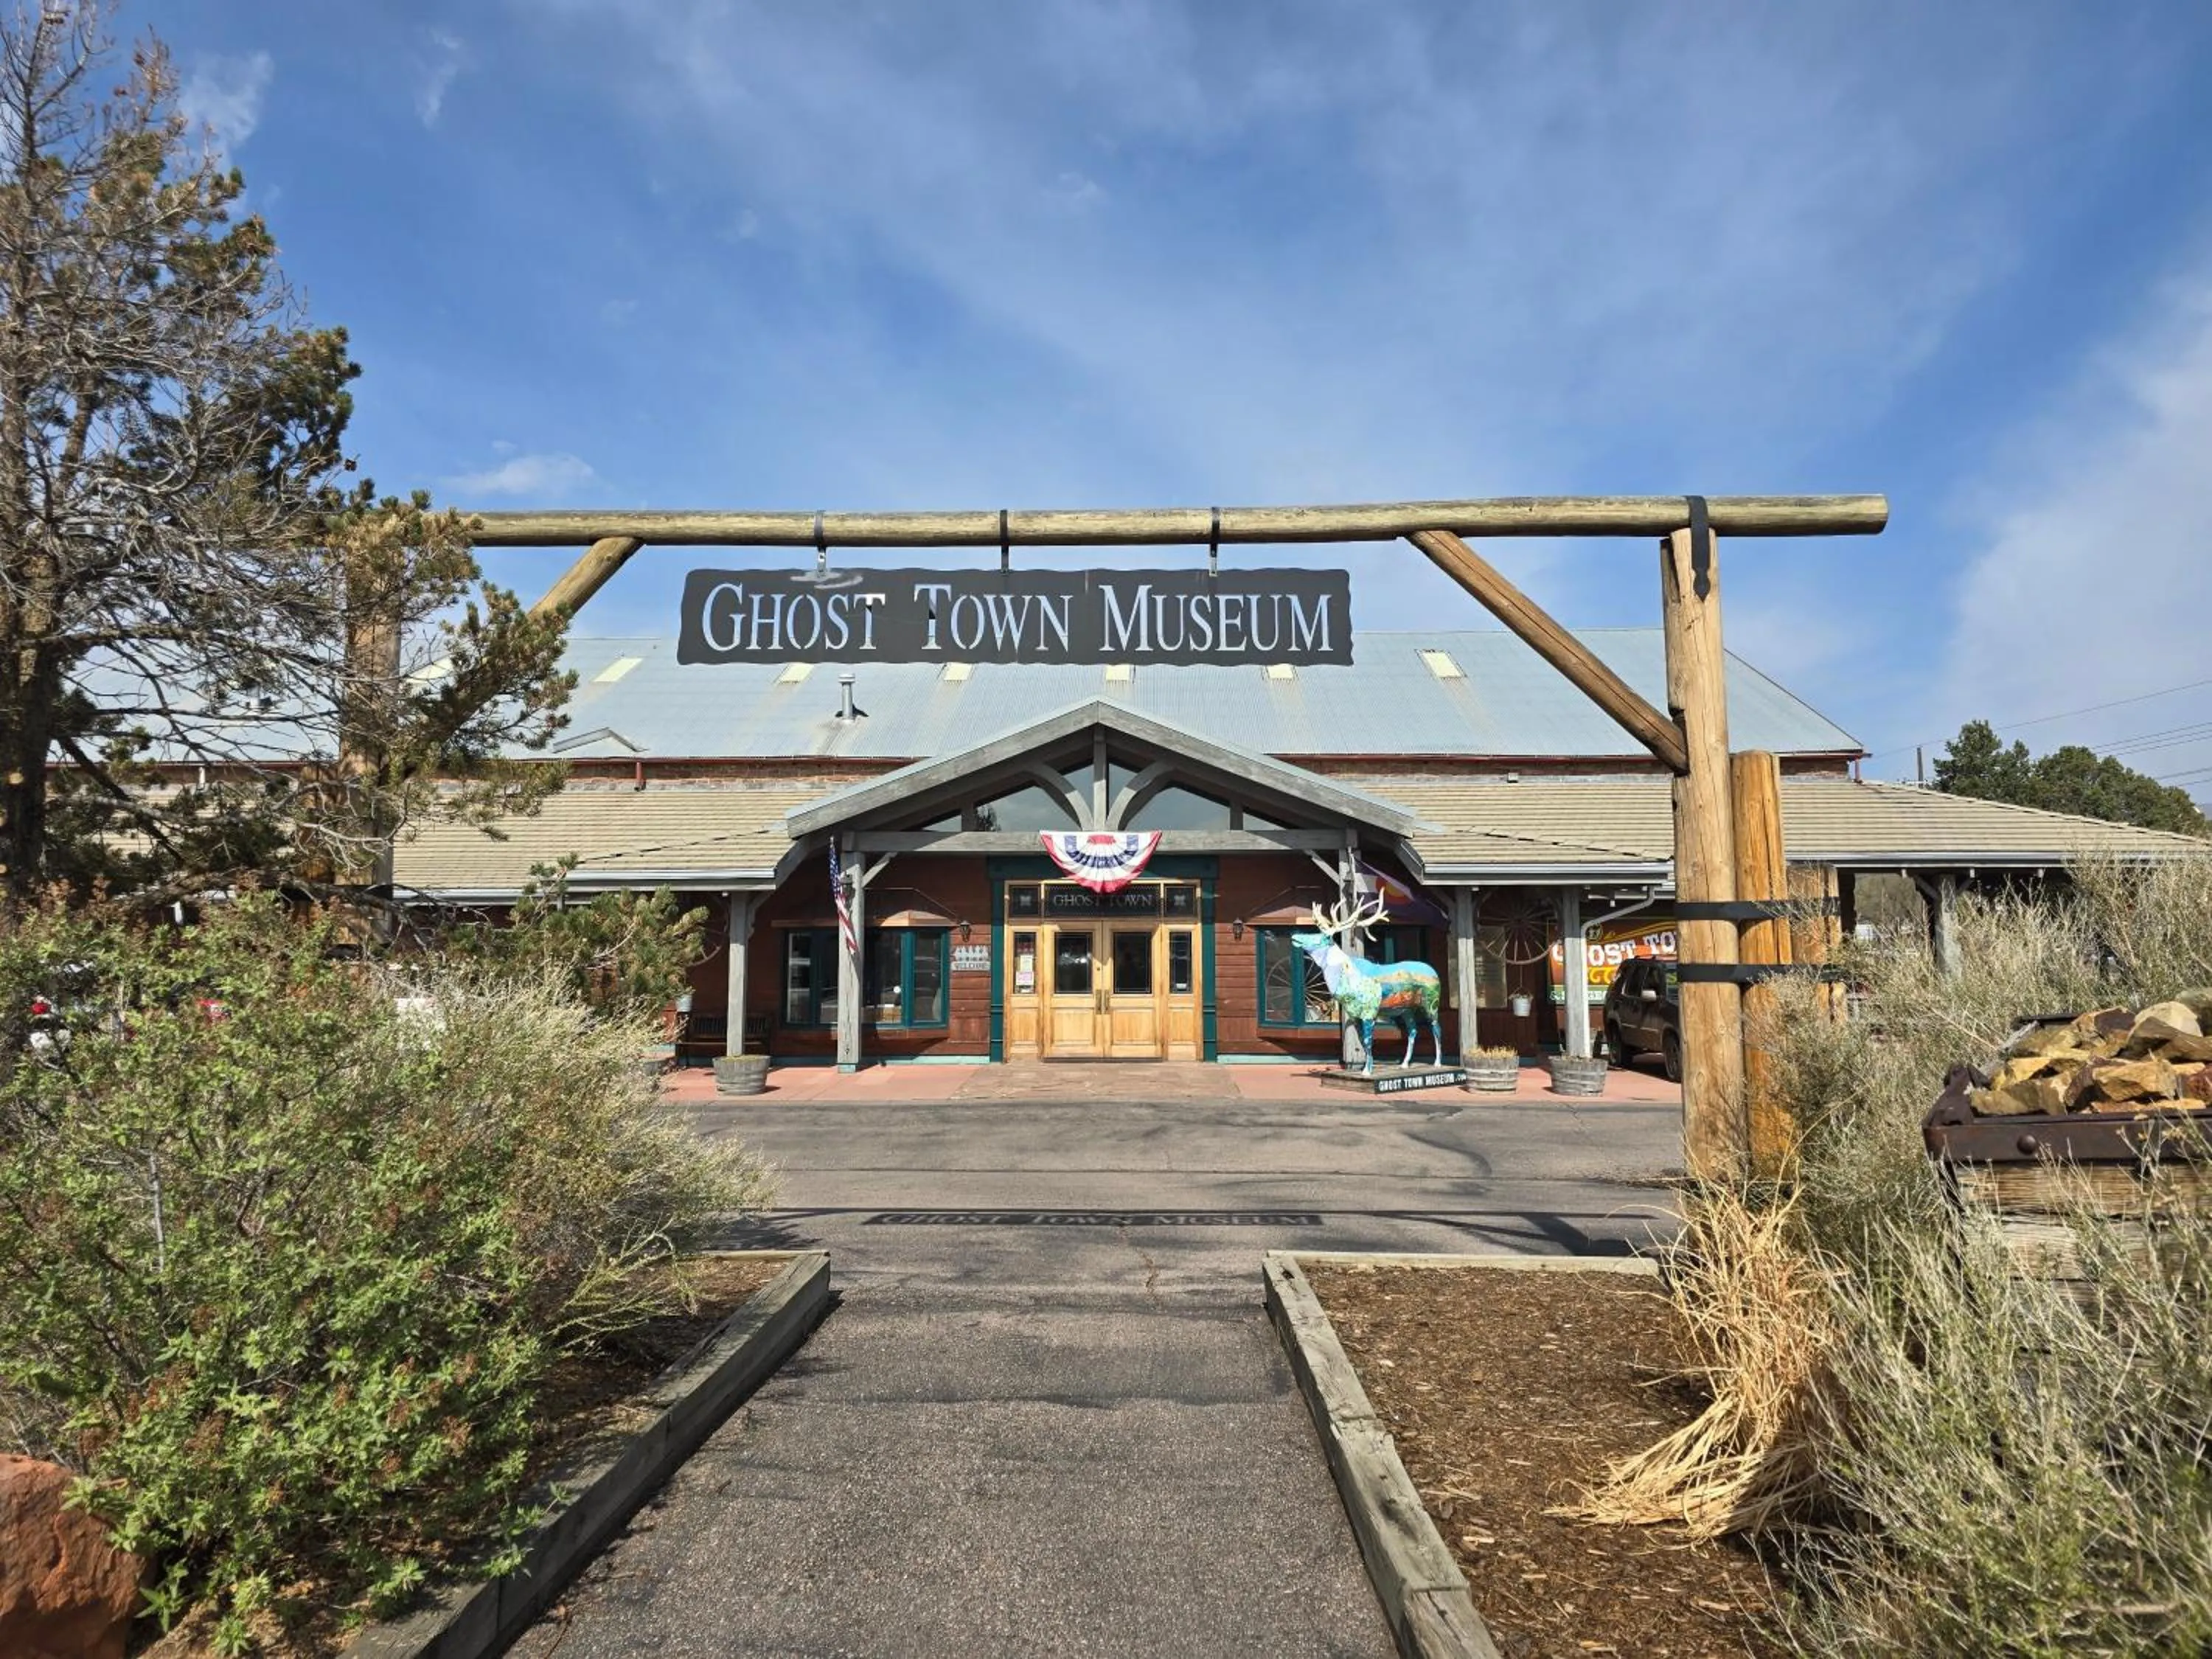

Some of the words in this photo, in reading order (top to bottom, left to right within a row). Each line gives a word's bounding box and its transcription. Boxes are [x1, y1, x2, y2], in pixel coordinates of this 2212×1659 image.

[701, 582, 886, 652] GHOST
[914, 582, 1074, 653] TOWN
[1099, 584, 1334, 652] MUSEUM
[1053, 894, 1101, 907] GHOST
[1107, 894, 1153, 907] TOWN
[1378, 1079, 1402, 1092] GHOST
[1403, 1077, 1423, 1090] TOWN
